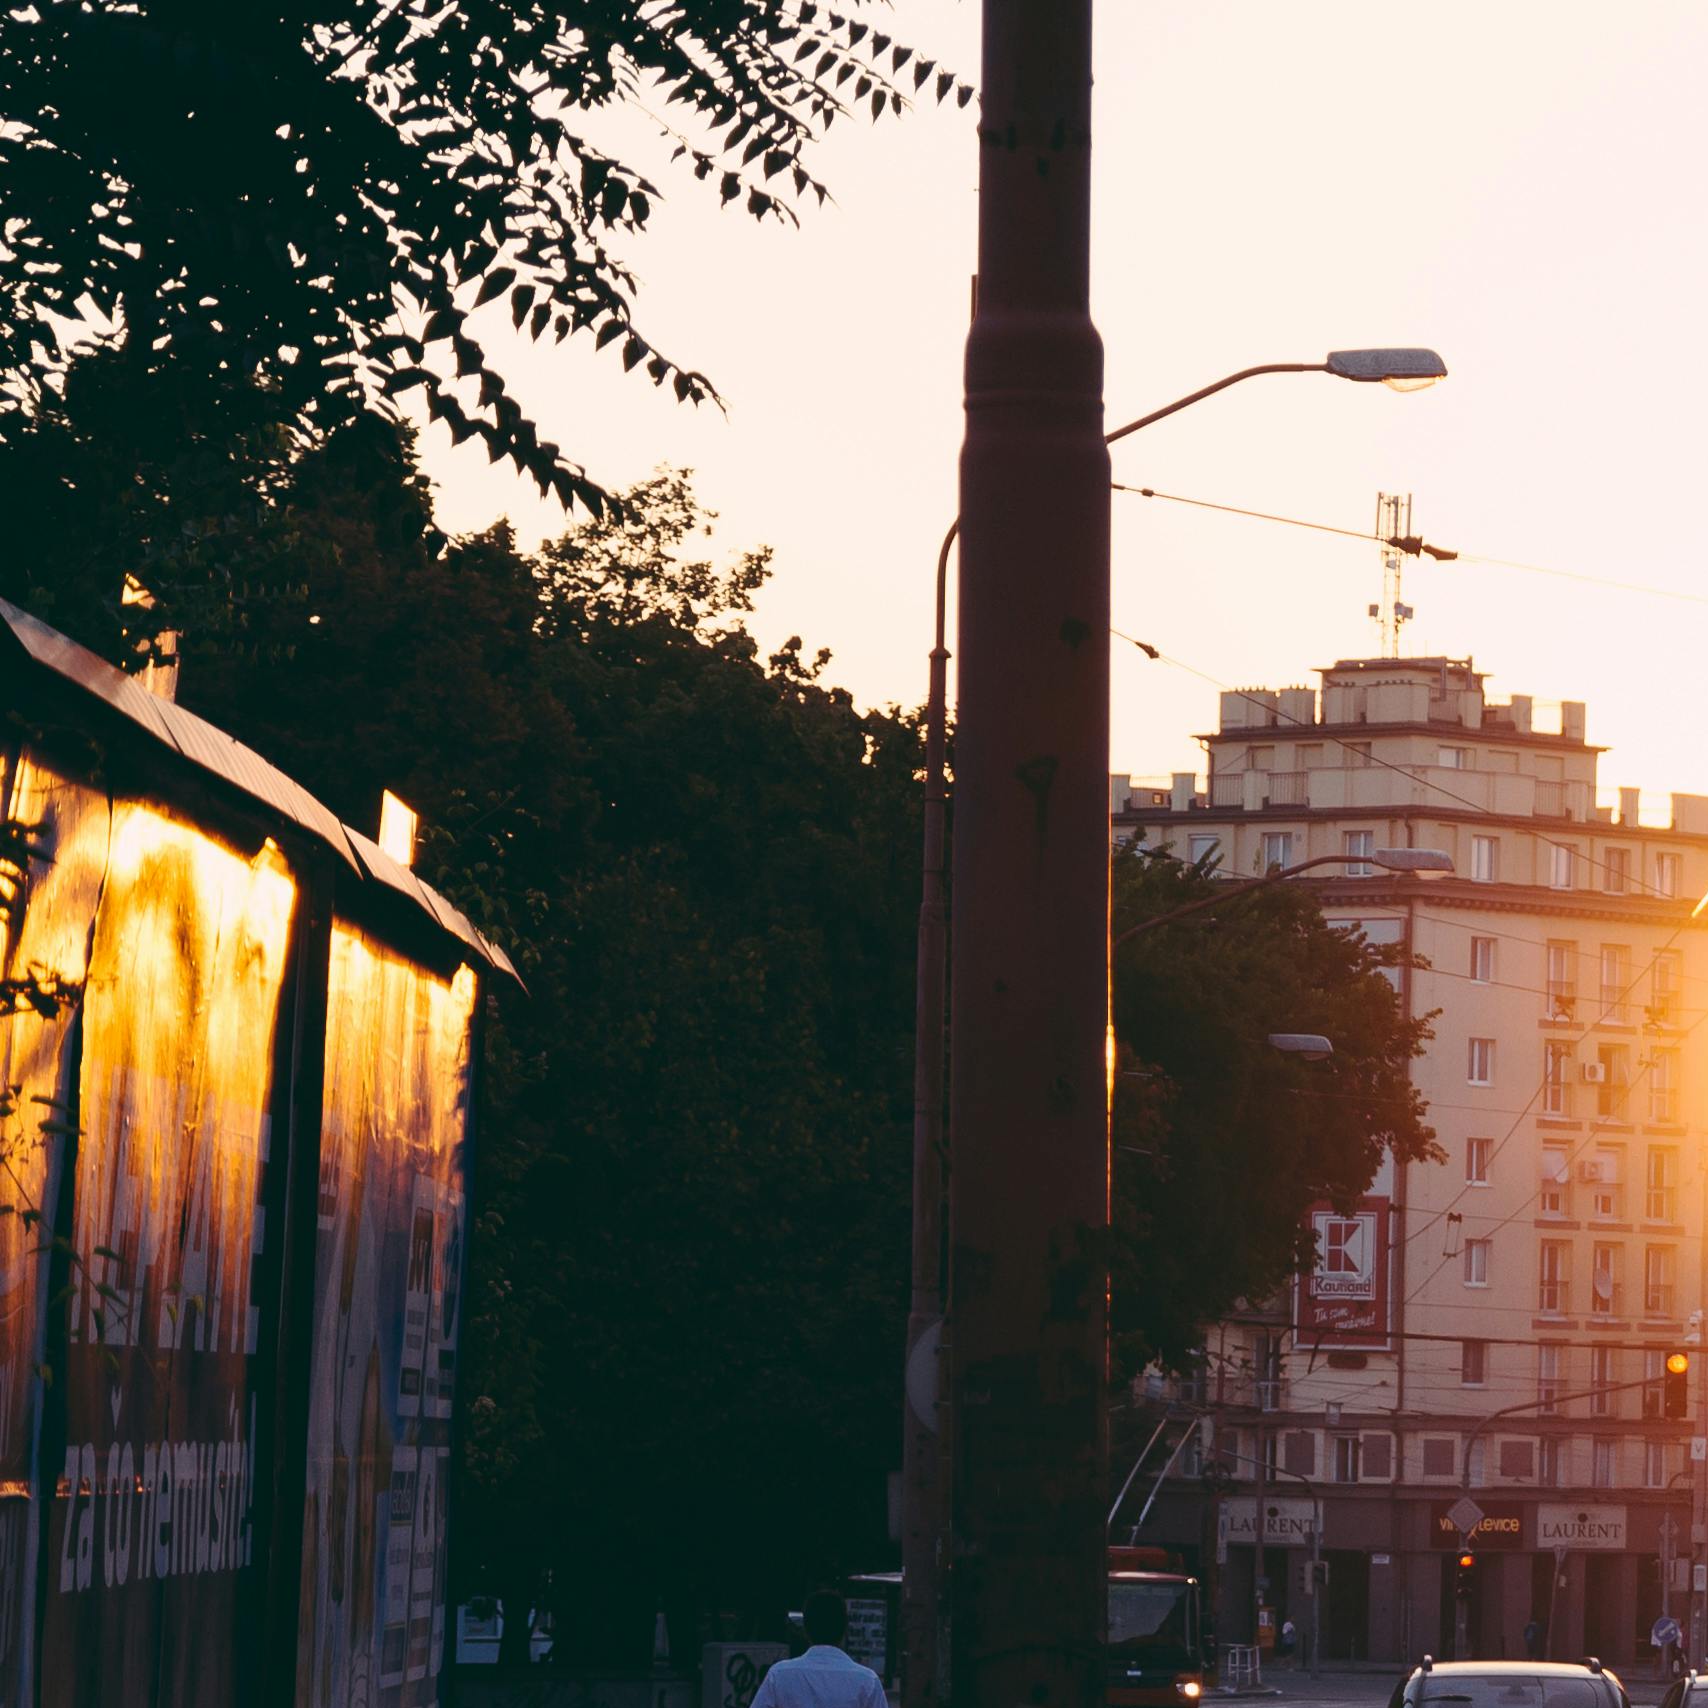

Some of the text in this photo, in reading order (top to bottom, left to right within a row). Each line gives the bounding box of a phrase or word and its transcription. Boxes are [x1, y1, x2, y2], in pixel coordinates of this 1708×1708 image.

[60, 1442, 97, 1592] za
[104, 1385, 134, 1588] čo
[137, 1388, 253, 1581] nemusíte!
[1543, 1523, 1622, 1538] LAURENT
